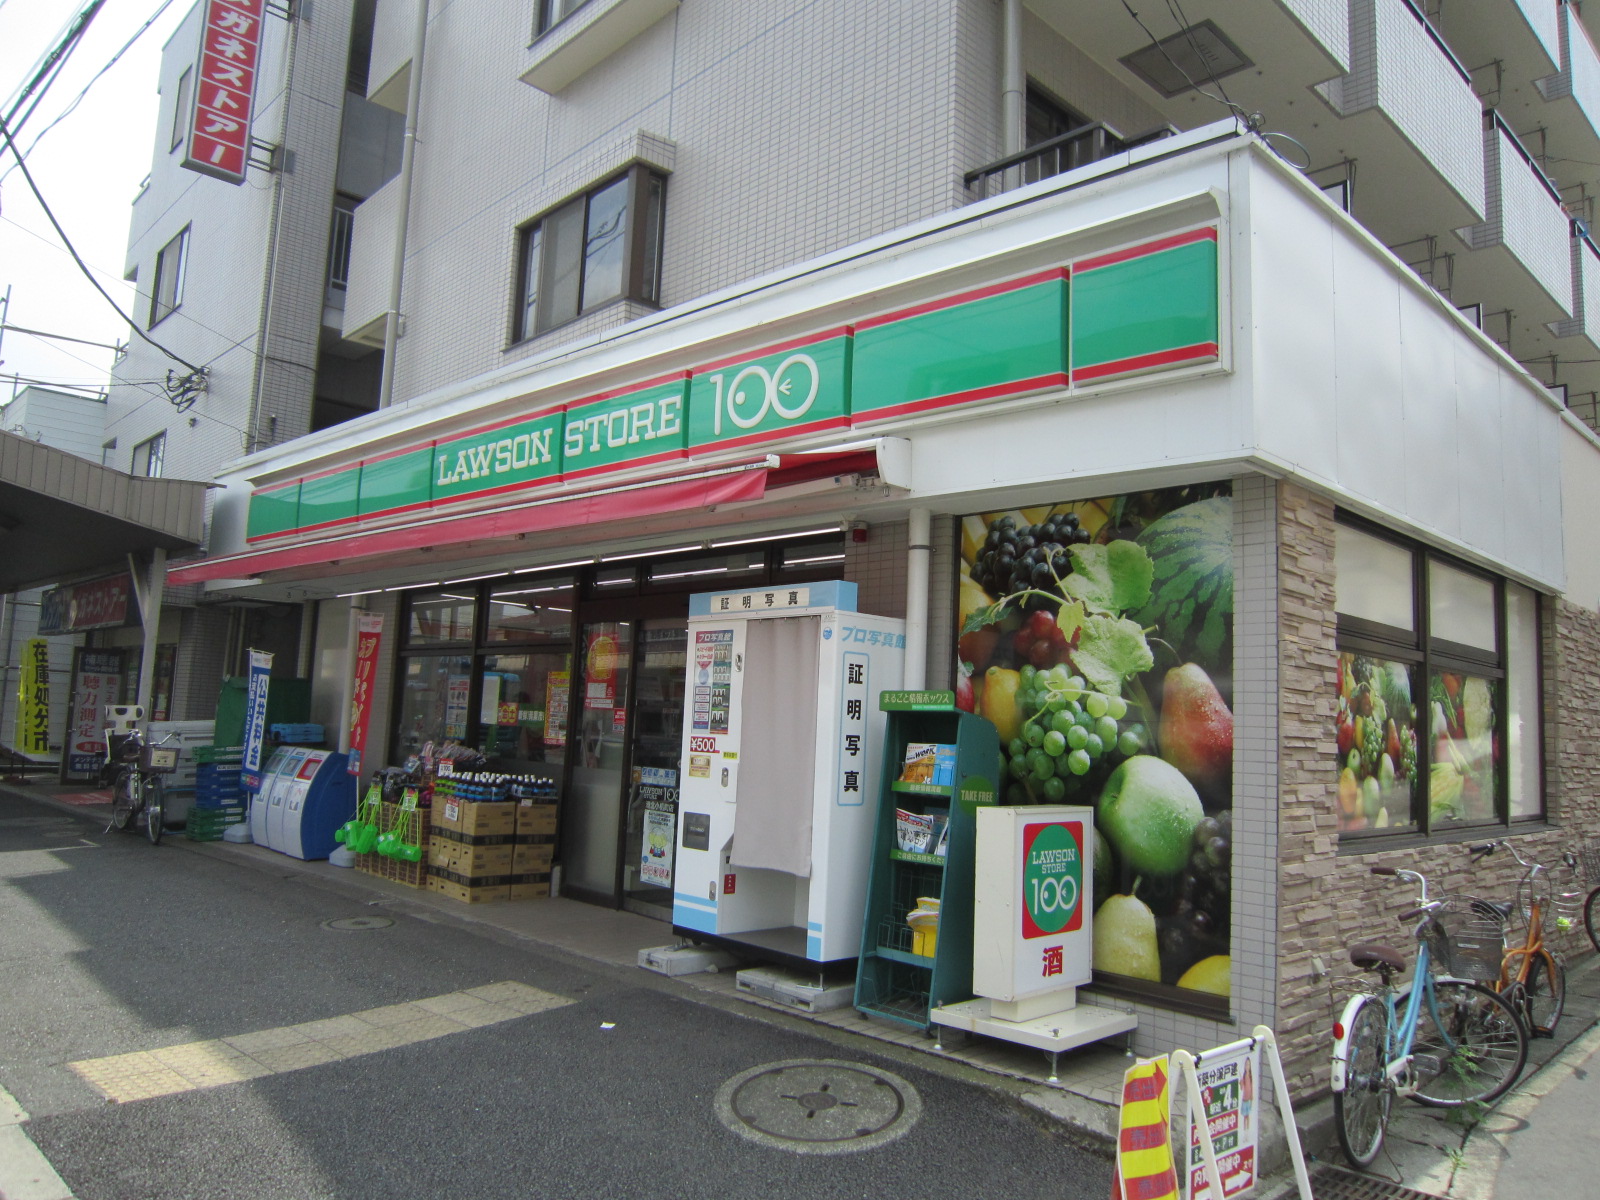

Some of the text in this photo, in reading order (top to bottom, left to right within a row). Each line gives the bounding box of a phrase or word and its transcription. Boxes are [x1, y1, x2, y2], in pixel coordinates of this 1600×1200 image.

[204, 0, 253, 164] ガネストアー
[437, 354, 819, 485] LAWSON STORE 100
[721, 591, 798, 610] 証明写真
[844, 664, 863, 792] 証明写真
[691, 738, 715, 751] ¥500
[961, 790, 993, 802] TAKE FREE
[1032, 848, 1075, 866] LAWSON
[1041, 862, 1066, 874] STORE
[1032, 875, 1077, 915] 100
[1042, 945, 1064, 977] 酒
